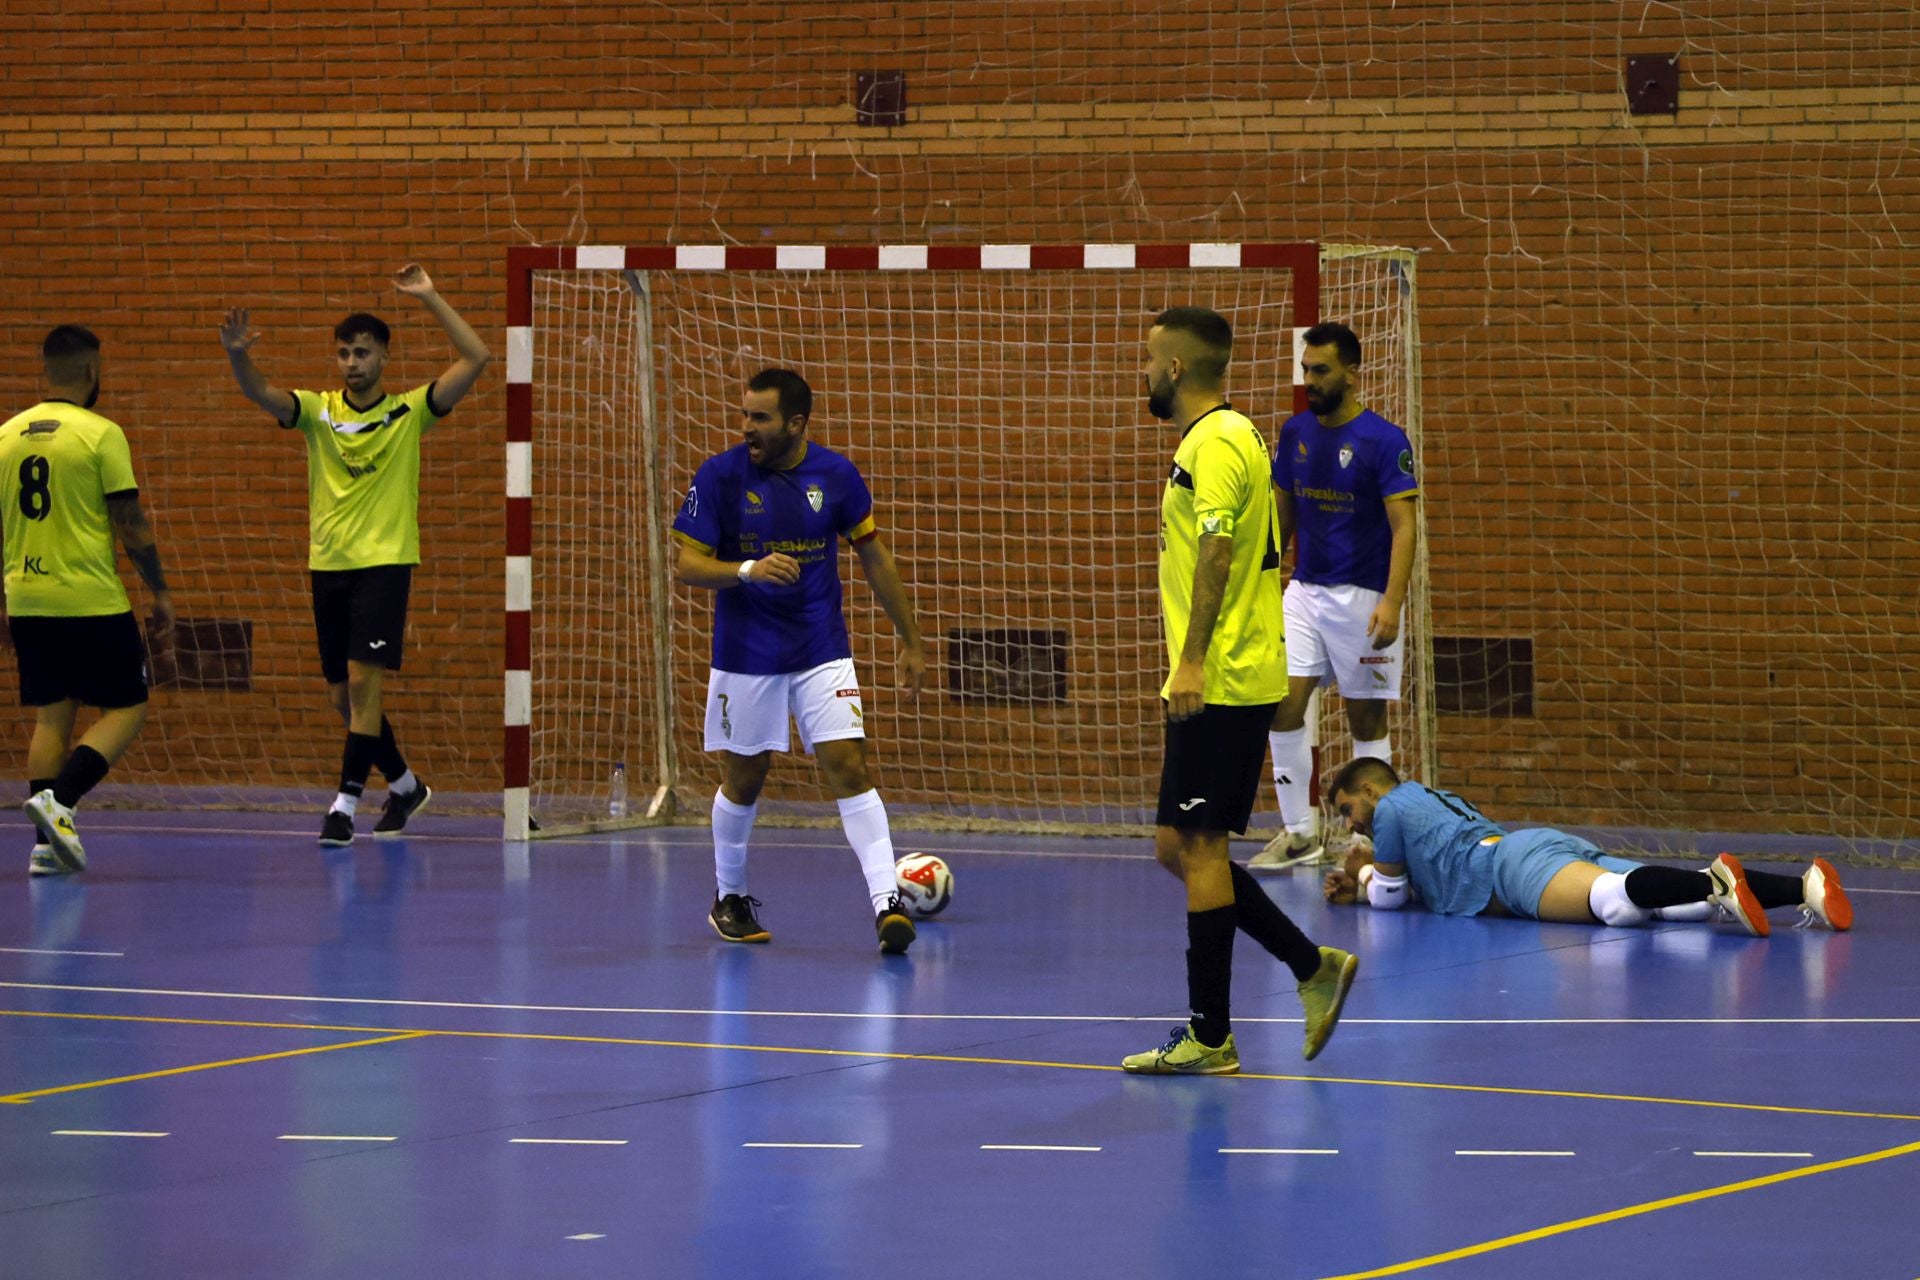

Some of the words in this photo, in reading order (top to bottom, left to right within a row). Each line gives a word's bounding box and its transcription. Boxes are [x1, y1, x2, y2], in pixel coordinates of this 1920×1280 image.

[19, 454, 51, 522] 8
[741, 542, 759, 554] EL
[24, 555, 49, 575] KC
